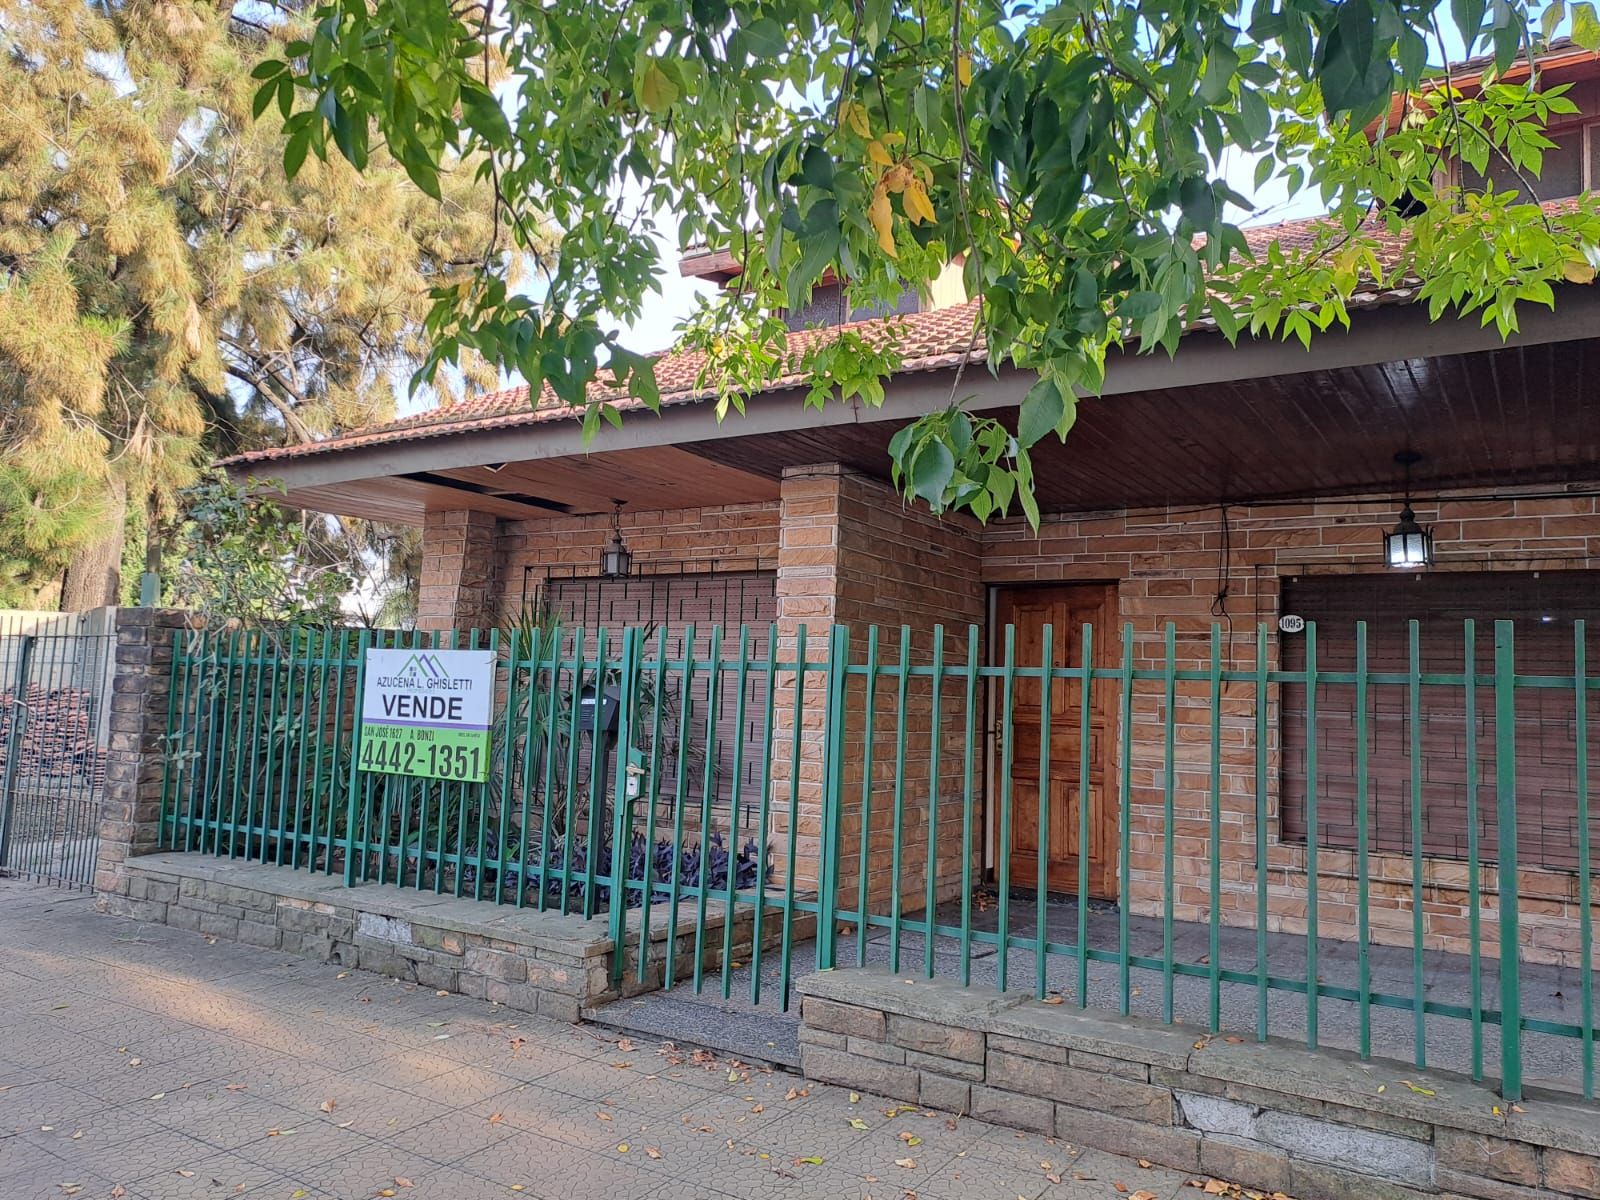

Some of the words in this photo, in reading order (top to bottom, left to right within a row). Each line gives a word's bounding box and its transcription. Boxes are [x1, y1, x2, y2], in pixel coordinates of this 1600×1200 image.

[1281, 618, 1301, 629] 1095
[377, 676, 414, 689] AZUCENA
[417, 678, 424, 689] L.
[426, 678, 473, 690] GHISLETTI
[382, 694, 463, 720] VENDE
[390, 727, 402, 739] 1627
[417, 729, 434, 741] BONZI
[361, 739, 480, 779] 4442-1351
